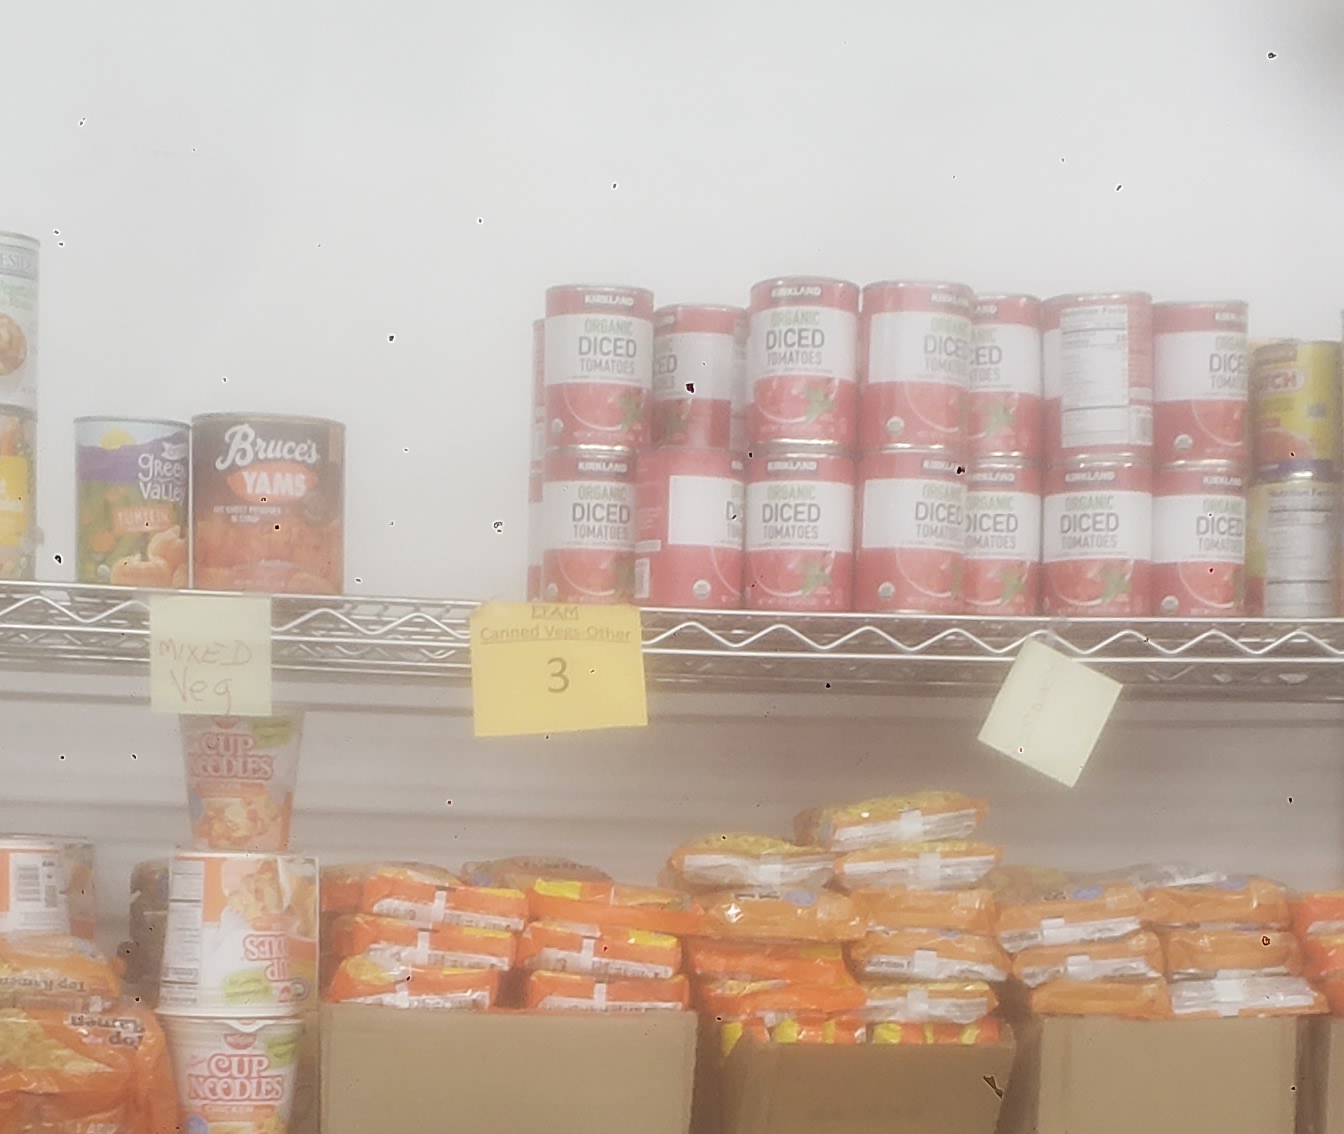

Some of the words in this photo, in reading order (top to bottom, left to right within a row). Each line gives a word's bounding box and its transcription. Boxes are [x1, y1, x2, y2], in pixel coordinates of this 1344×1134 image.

[584, 292, 635, 307] KIRKLAND
[770, 284, 822, 298] KIRKLAND
[584, 317, 634, 335] ORGANIC
[770, 310, 821, 328] ORGANIC
[577, 335, 638, 358] DICED
[764, 327, 826, 350] DICED
[922, 333, 969, 357] DICE
[579, 357, 636, 376] TOMATOES
[766, 349, 823, 367] TOMATOES
[1208, 352, 1247, 374] DICE
[215, 423, 321, 471] Bruce's
[577, 460, 629, 473] KIRKLAND
[766, 459, 818, 473] KIRKLAND
[242, 471, 307, 496] YAMS
[1064, 470, 1116, 484] KIRKLAND
[577, 484, 628, 501] ORGANIC
[766, 484, 817, 501] ORGANIC
[571, 501, 632, 524] DICED
[761, 501, 822, 524] DICED
[1064, 494, 1115, 512] ORGANIC
[572, 523, 630, 541] TOMATOES
[762, 523, 819, 541] TOMATOES
[1059, 512, 1120, 535] DICED
[1061, 535, 1118, 552] TOMATOES
[480, 625, 540, 641] Canned
[159, 637, 253, 667] MIXED
[546, 656, 570, 694] 3
[169, 666, 233, 716] Veg
[199, 731, 255, 756] CUP
[264, 960, 289, 981] UP
[207, 1053, 270, 1079] CUP
[188, 1073, 284, 1102] NOODLES
